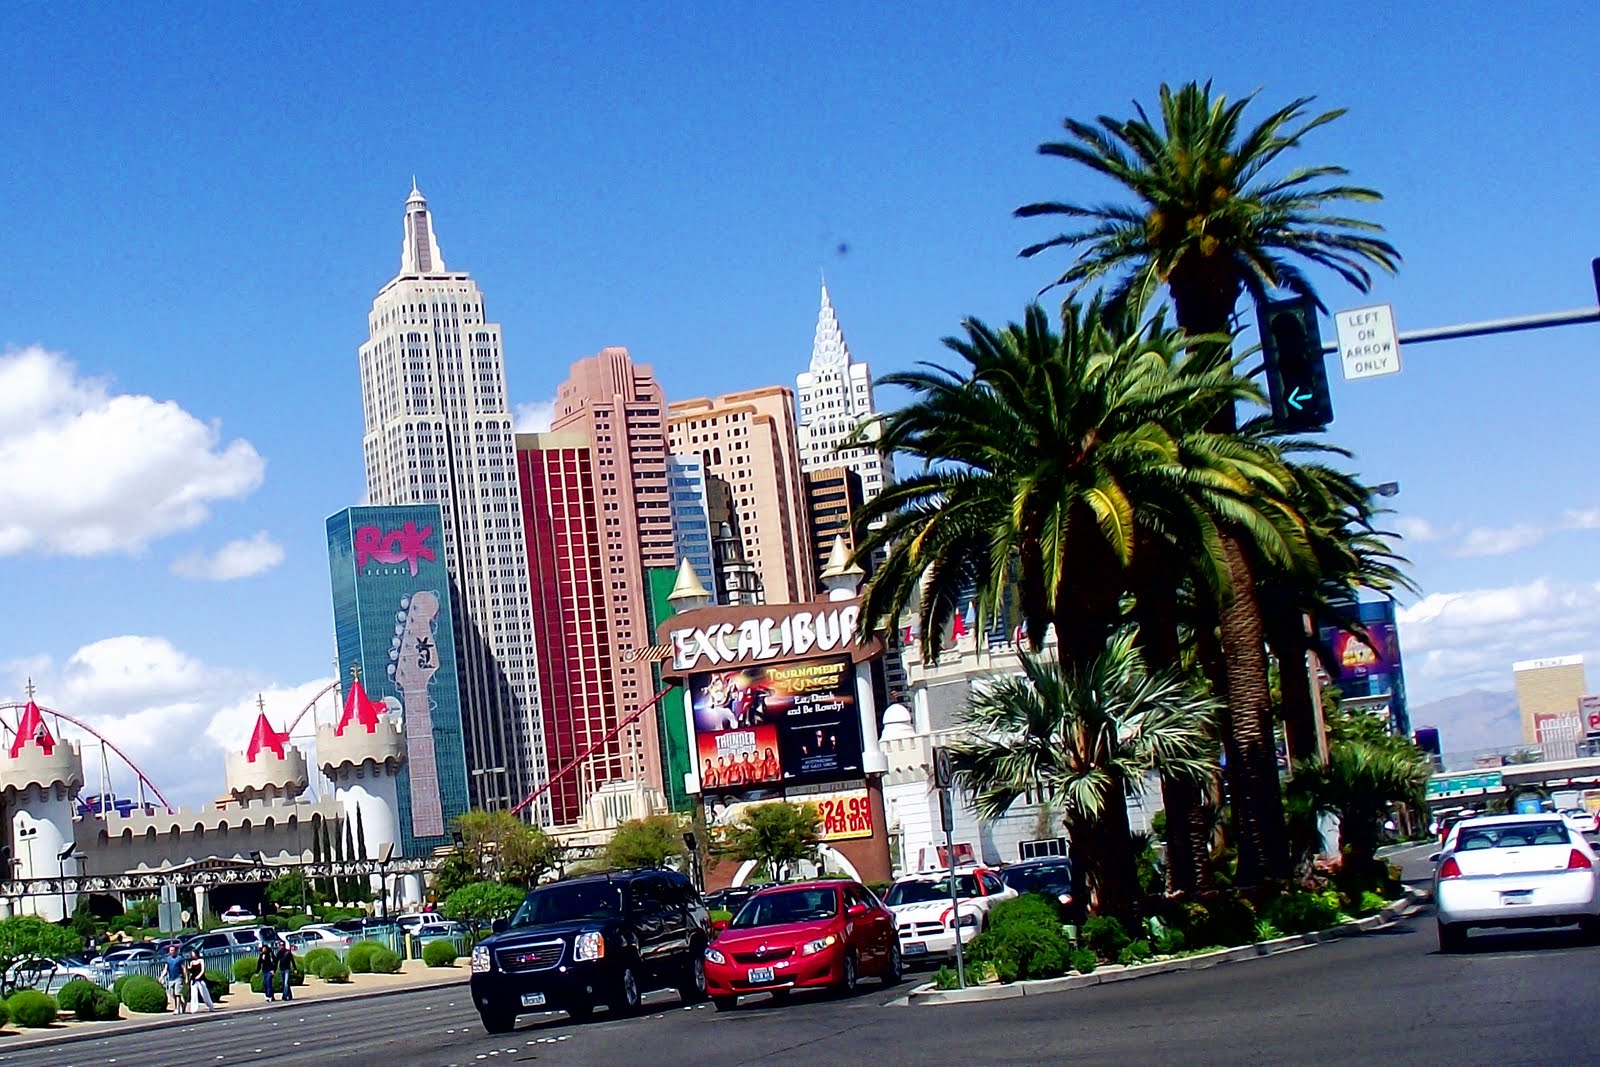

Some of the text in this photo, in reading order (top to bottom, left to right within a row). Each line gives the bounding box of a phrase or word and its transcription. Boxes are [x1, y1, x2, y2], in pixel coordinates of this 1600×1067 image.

[1349, 312, 1378, 327] LEFT
[1358, 329, 1375, 341] ON
[1346, 343, 1391, 359] ARROW
[1355, 358, 1388, 373] ONLY
[785, 675, 839, 692] KINGS
[811, 691, 835, 703] Drink
[787, 700, 845, 716] and Be Rowdy!
[714, 731, 756, 750] THUNDER
[818, 797, 870, 820] $24.99
[825, 817, 847, 834] PER
[849, 815, 872, 832] DAY
